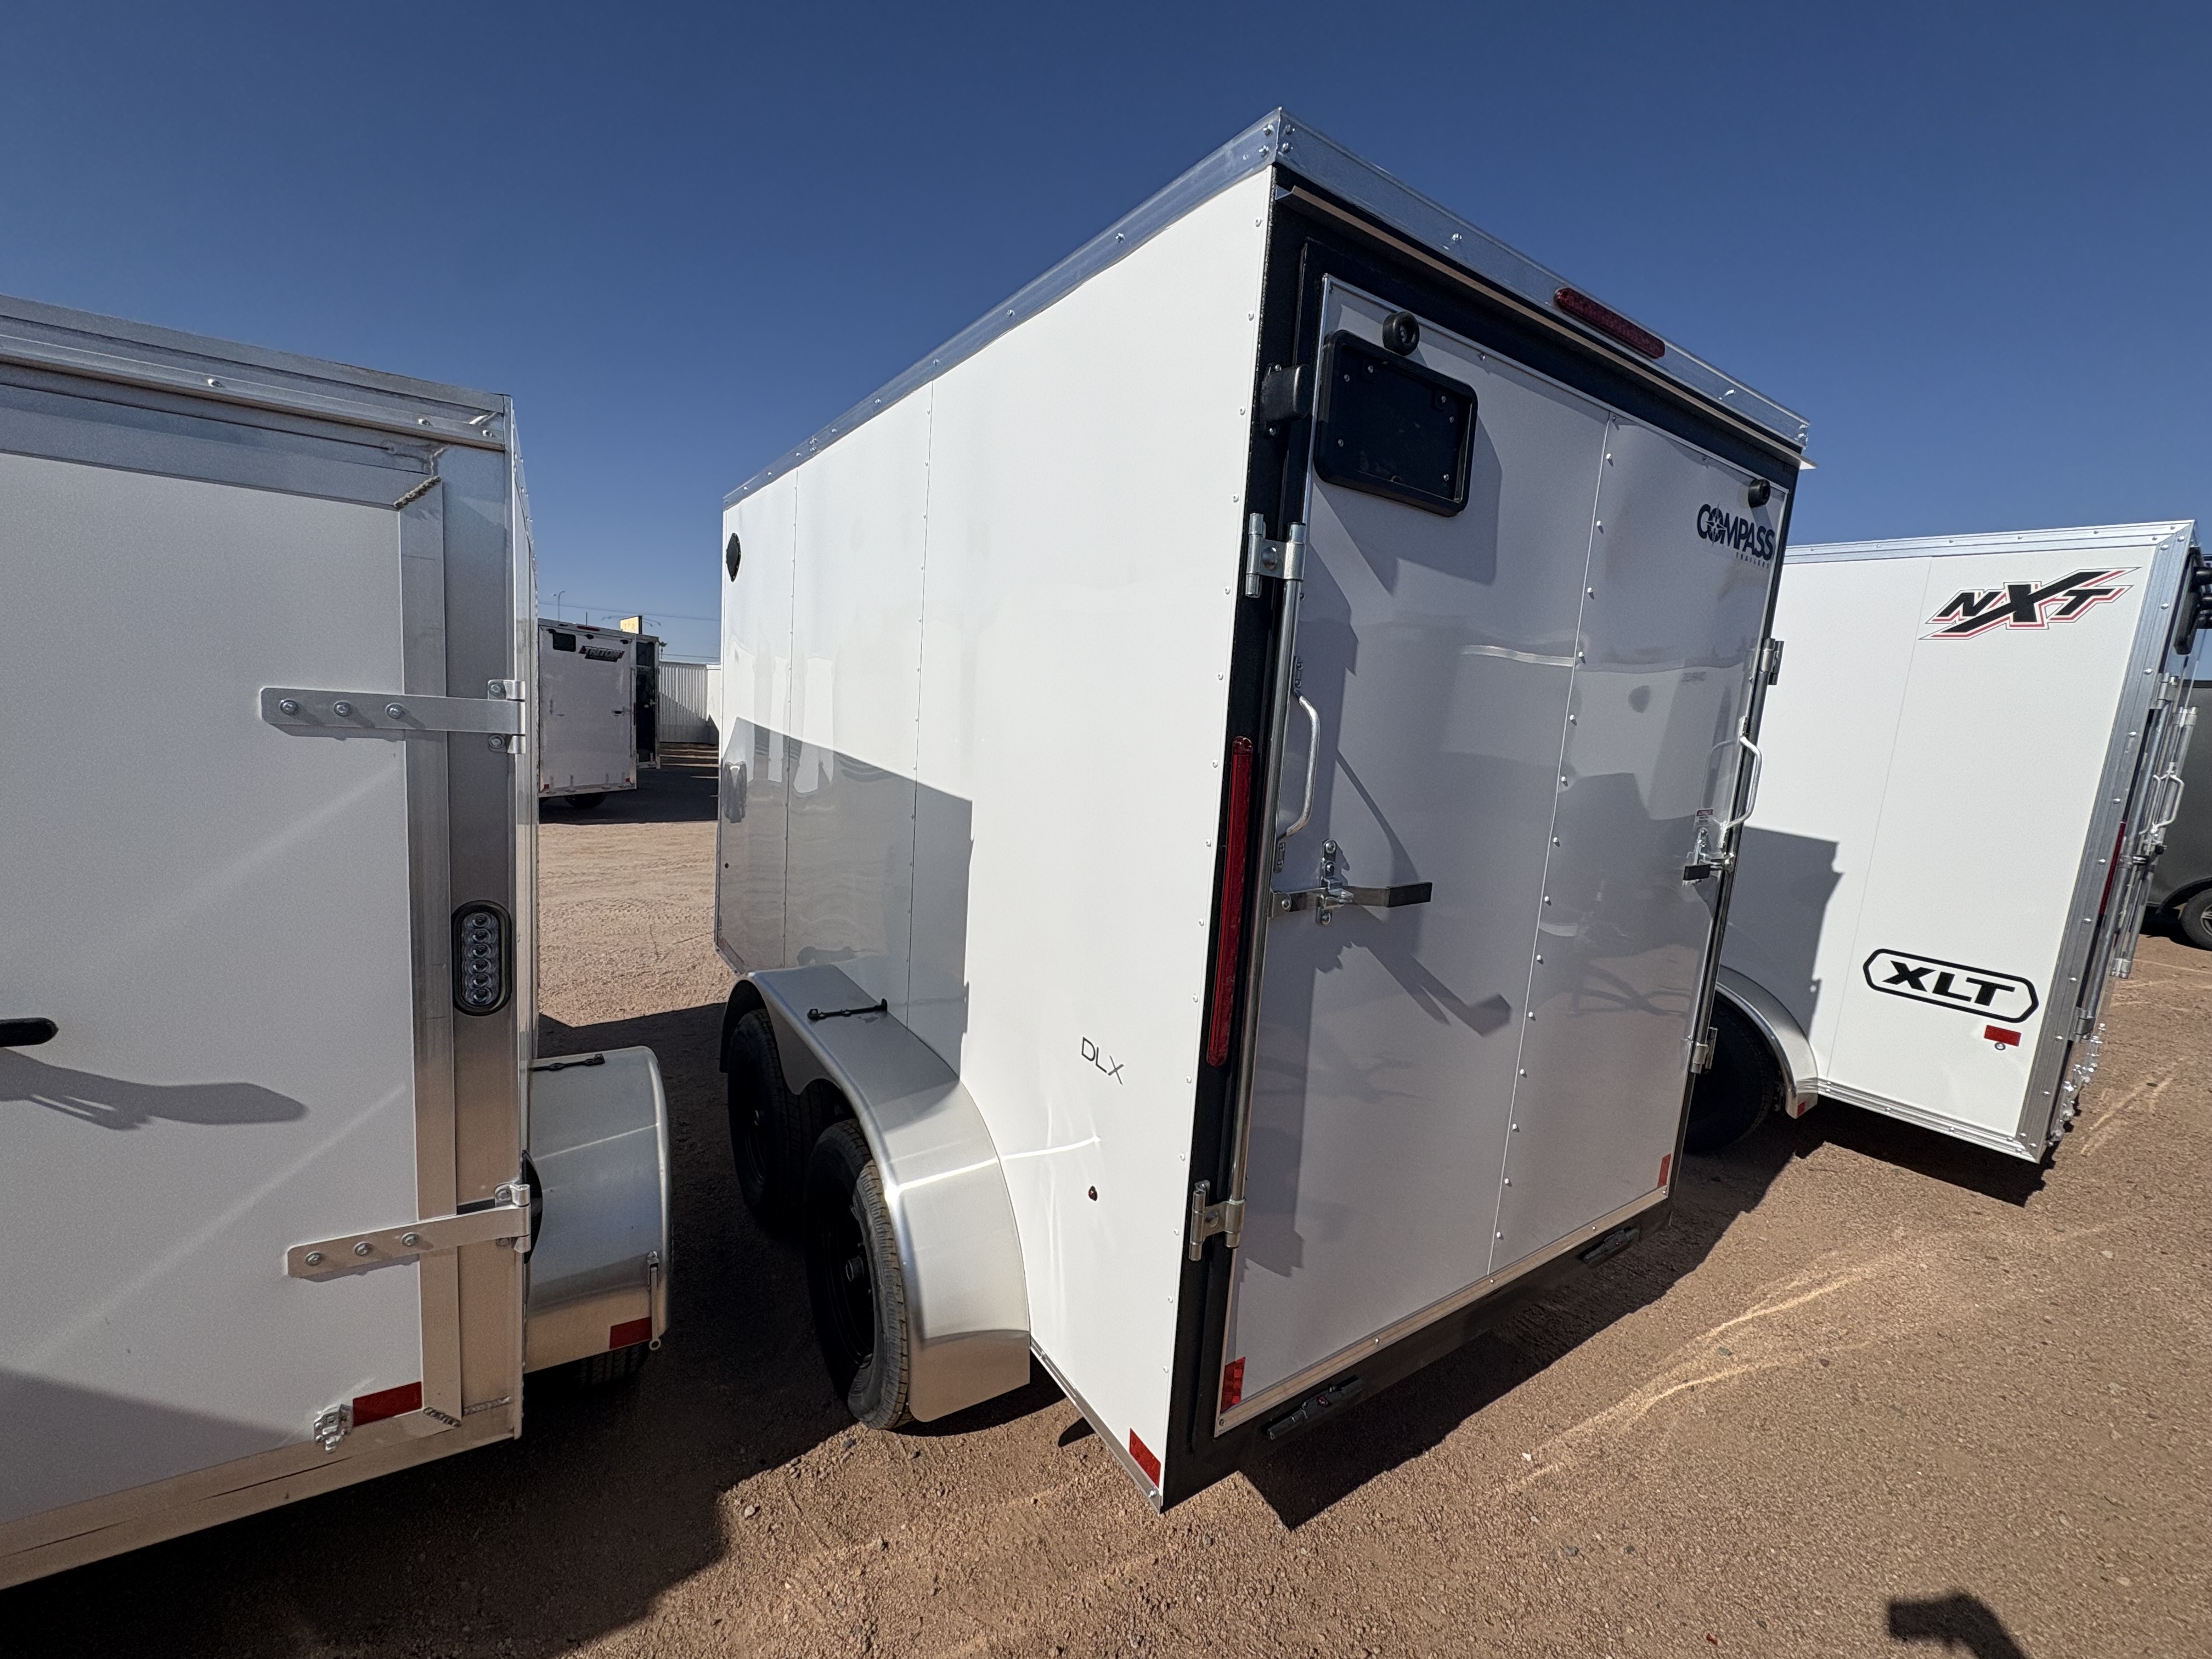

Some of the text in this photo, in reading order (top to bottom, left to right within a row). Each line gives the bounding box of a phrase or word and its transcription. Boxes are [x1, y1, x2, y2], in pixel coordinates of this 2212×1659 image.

[1697, 503, 1775, 561] COMPASS
[1735, 552, 1770, 569] TRAILERS
[1930, 570, 2126, 637] NXT
[1882, 960, 2016, 1007] XLT
[1081, 1036, 1125, 1086] DLX
